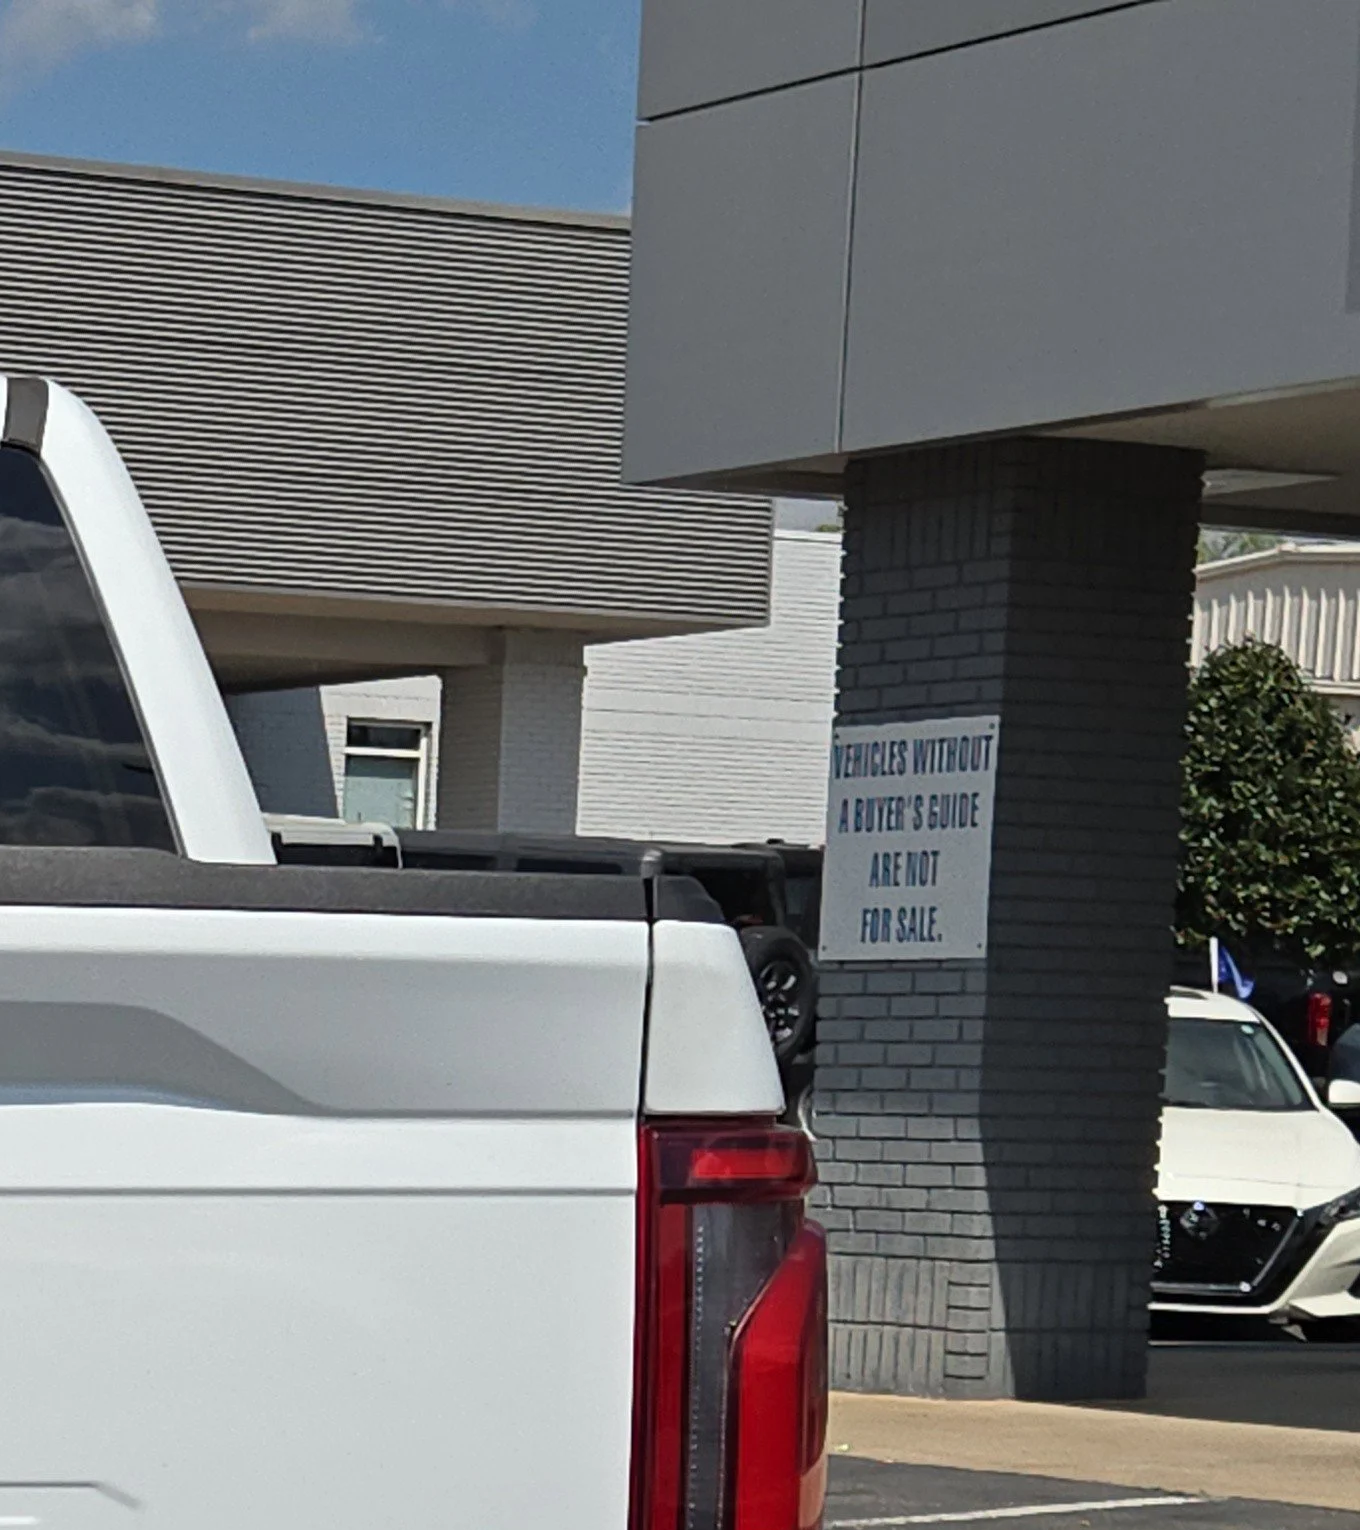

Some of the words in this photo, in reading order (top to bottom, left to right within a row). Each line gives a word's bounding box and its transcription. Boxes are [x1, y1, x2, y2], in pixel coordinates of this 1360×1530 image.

[833, 739, 908, 779] VEHICLES
[912, 735, 993, 775] WITHOUT
[837, 799, 849, 833] A
[854, 794, 924, 833] BUYER'S
[927, 792, 980, 830] GUIDE
[868, 851, 900, 888] ARE
[905, 850, 940, 887] NOT
[860, 907, 892, 943] FOR
[896, 906, 942, 943] SALE.
